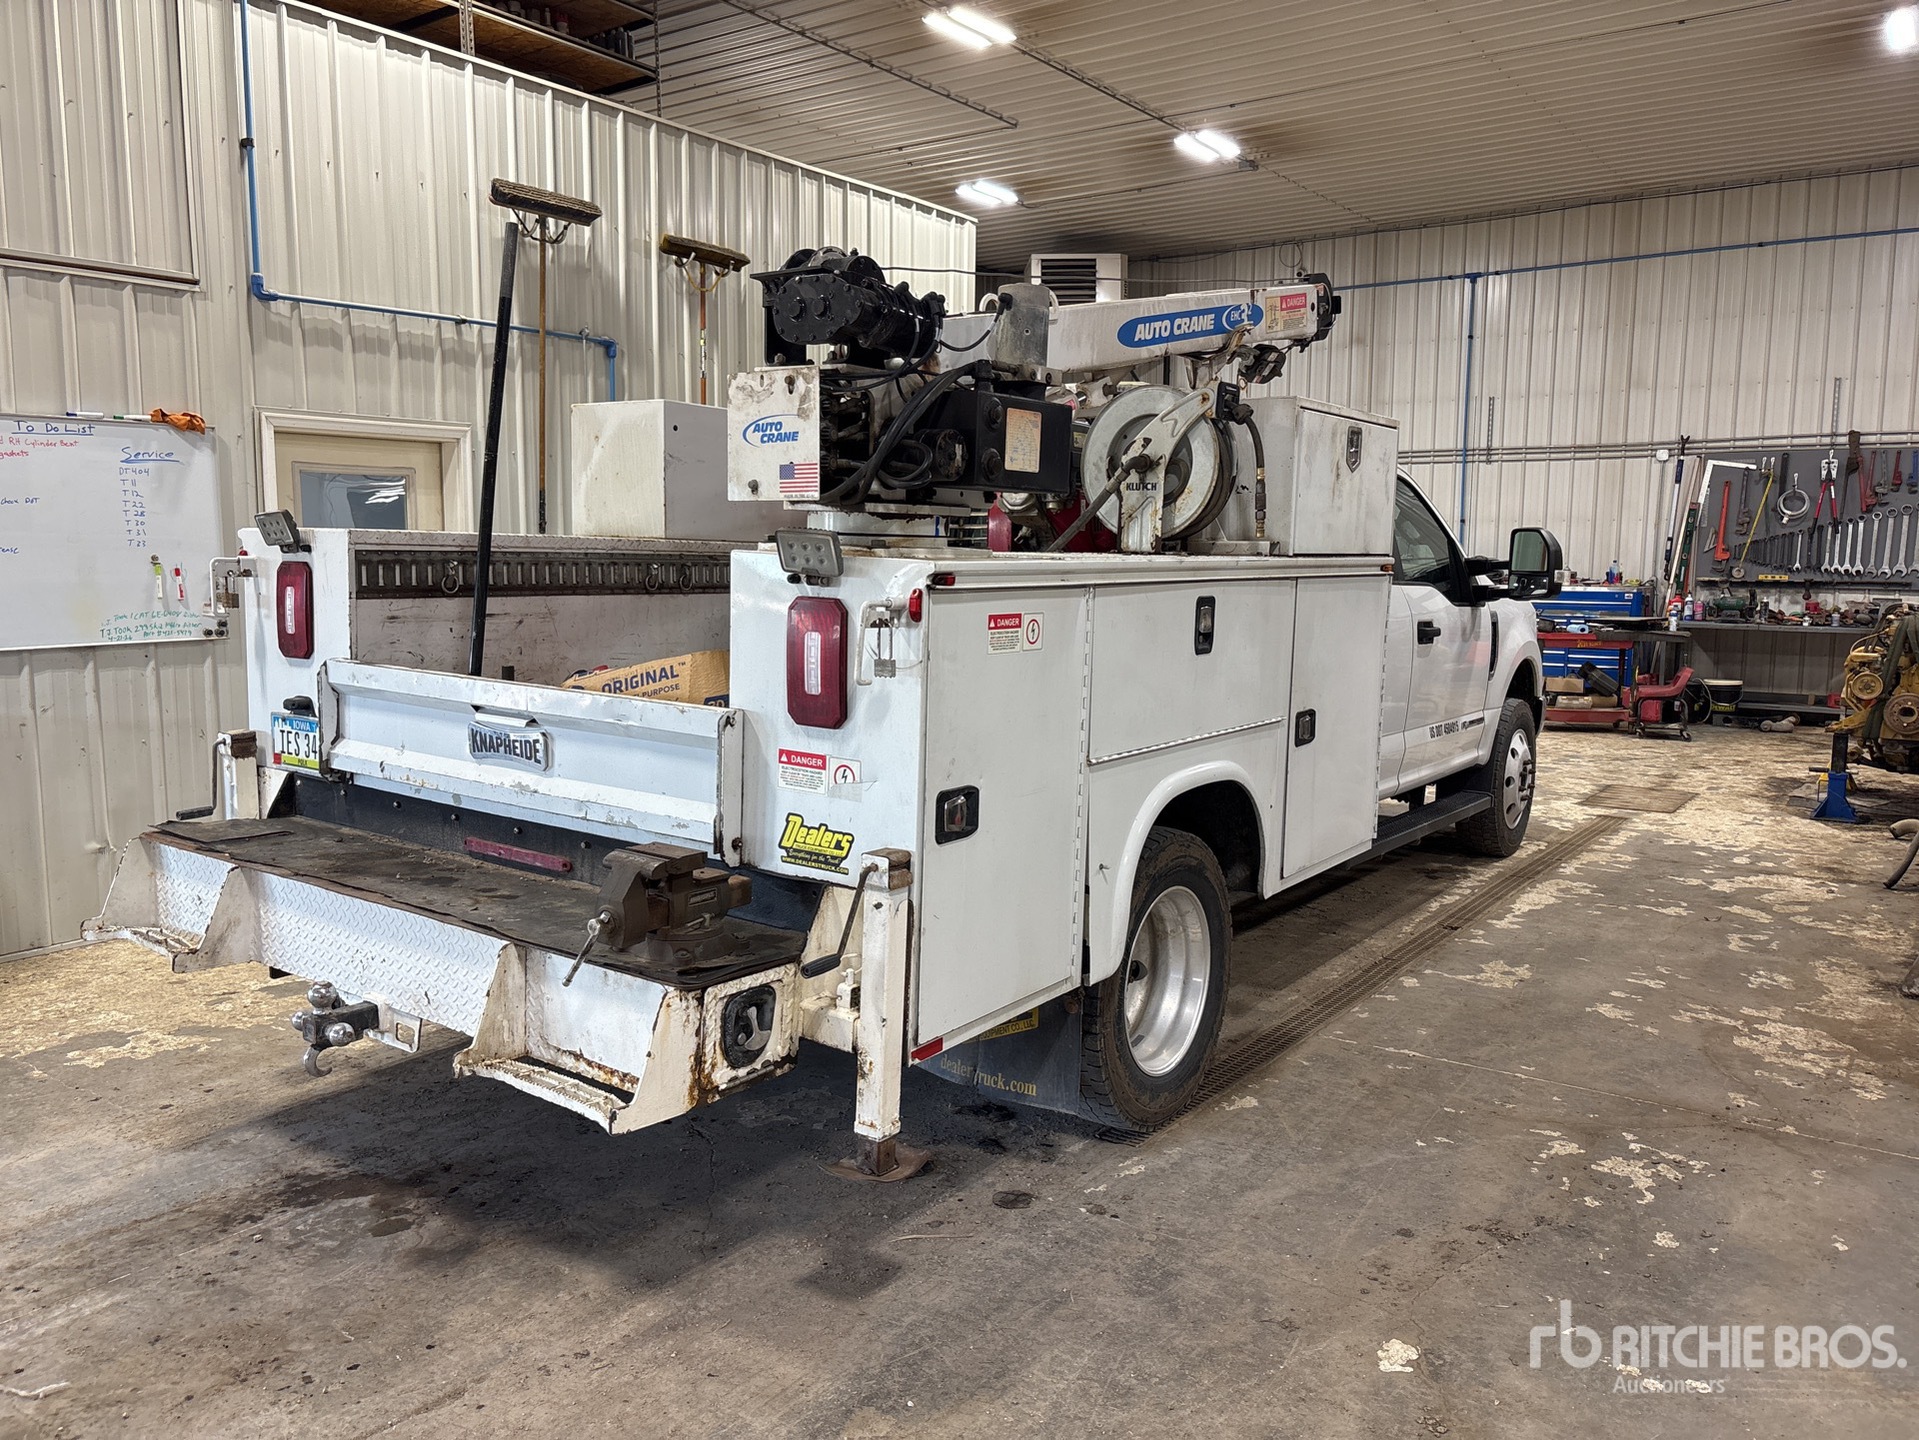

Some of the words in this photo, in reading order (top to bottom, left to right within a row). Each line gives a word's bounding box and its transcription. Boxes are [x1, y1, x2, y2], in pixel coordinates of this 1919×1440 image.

[1286, 297, 1305, 307] DANGER
[1134, 319, 1171, 342] AUTO
[1173, 313, 1215, 335] CRANE
[13, 420, 35, 432] To
[45, 423, 60, 433] Do
[64, 423, 95, 434] List
[752, 421, 783, 433] AUTO
[760, 431, 799, 444] CRANE
[121, 446, 174, 460] Service
[1126, 482, 1157, 491] KLUTCH
[997, 618, 1020, 627] DANGER
[602, 665, 680, 694] ORIGINAL
[293, 720, 311, 731] IOWA
[470, 728, 543, 765] KNAPHEIDE
[790, 755, 823, 767] DANGER
[780, 814, 853, 850] Dealers
